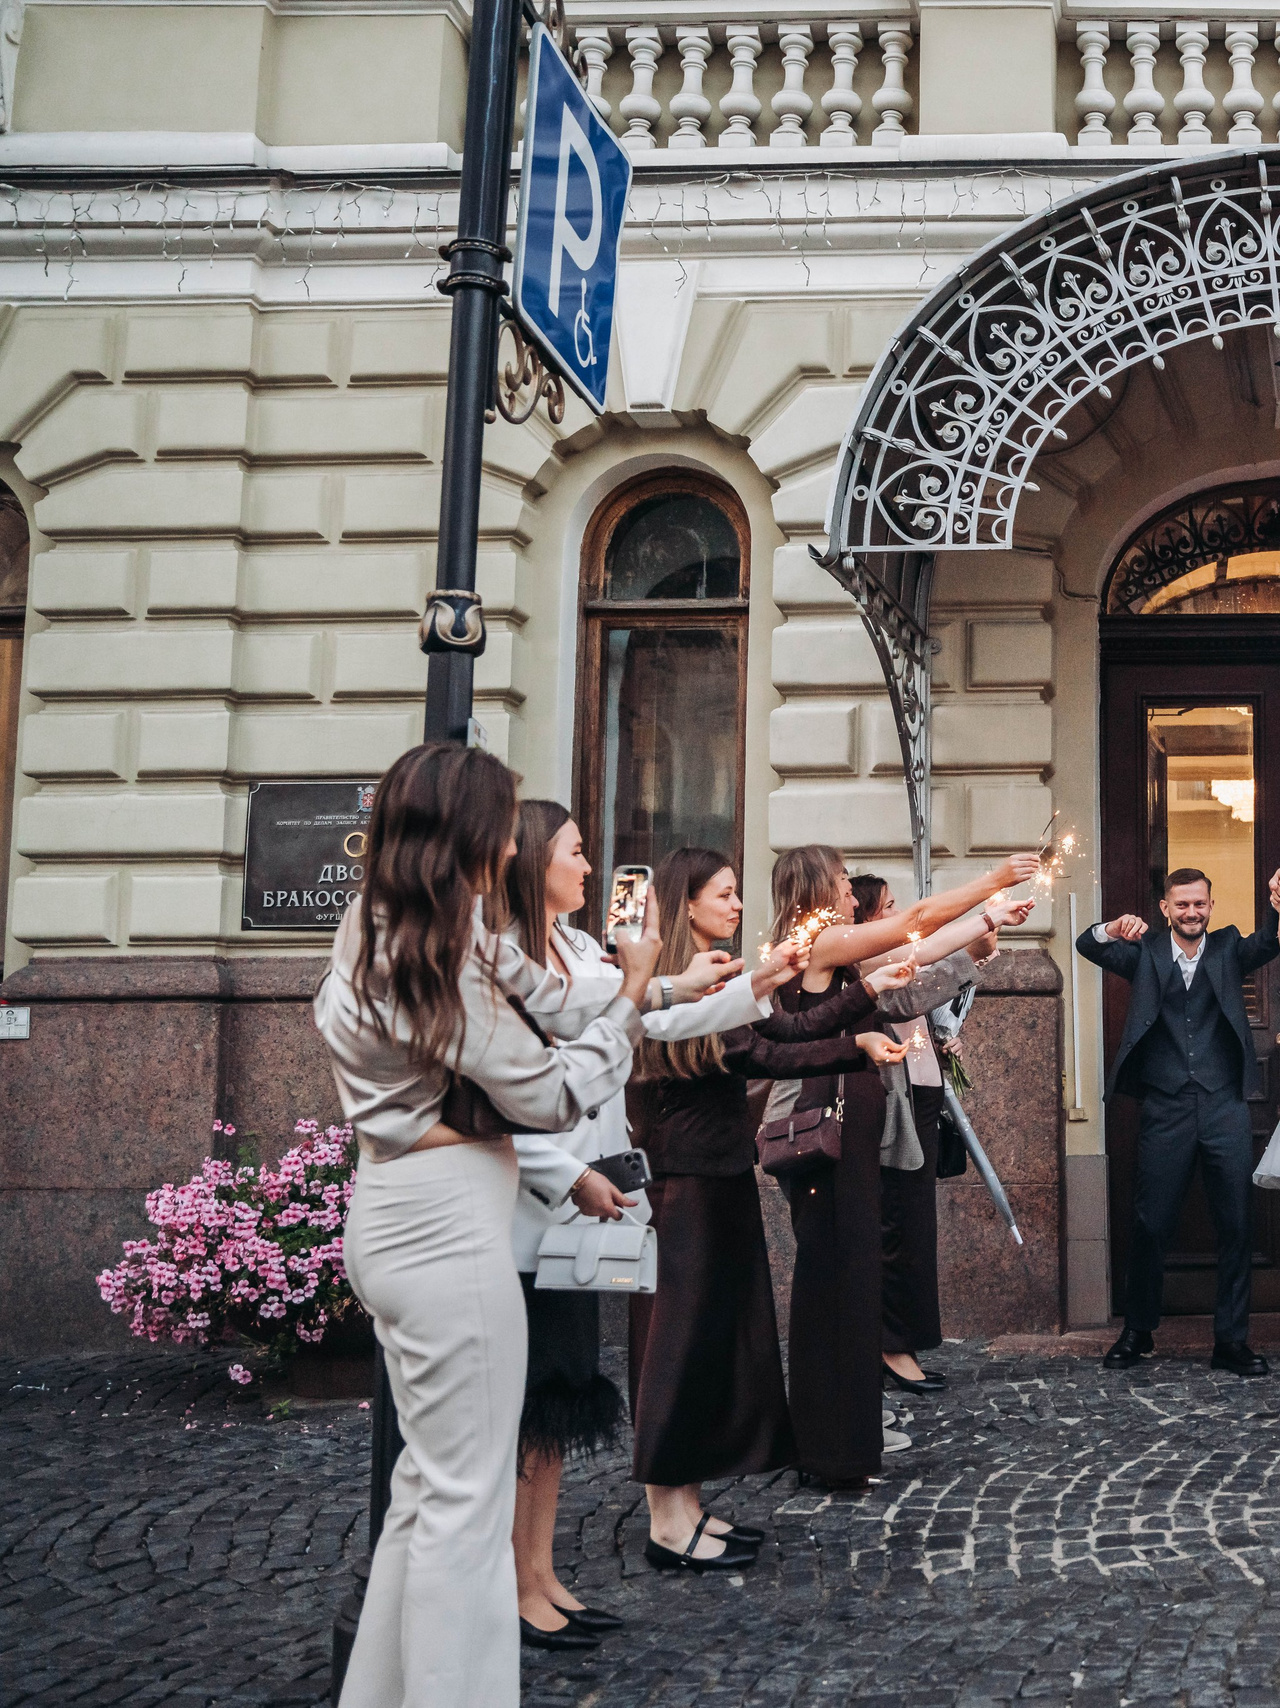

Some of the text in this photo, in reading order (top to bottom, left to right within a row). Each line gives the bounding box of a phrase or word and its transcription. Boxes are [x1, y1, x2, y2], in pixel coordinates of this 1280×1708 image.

[548, 101, 602, 318] P
[318, 864, 364, 884] ДВО
[262, 890, 356, 907] БРАКОСО
